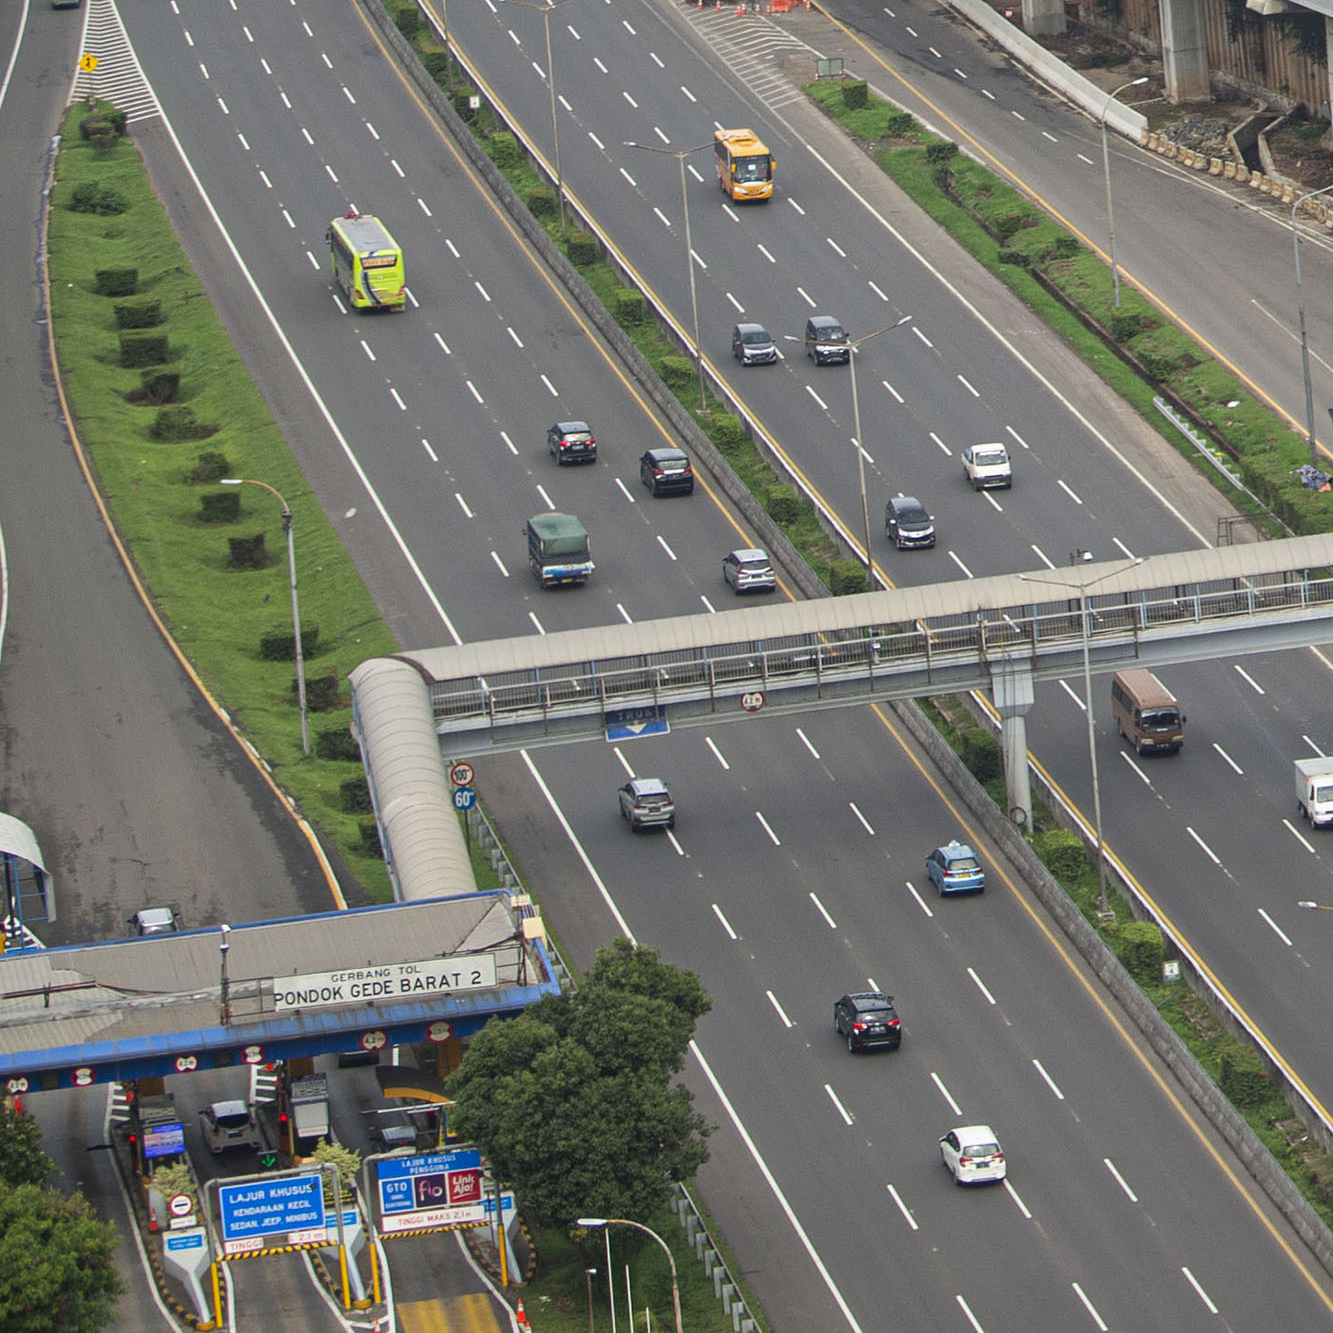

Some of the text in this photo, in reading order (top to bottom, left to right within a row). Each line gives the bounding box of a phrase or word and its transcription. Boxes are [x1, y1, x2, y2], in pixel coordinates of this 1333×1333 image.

[455, 791, 470, 807] 60
[331, 966, 421, 983] GERBANG TOL
[274, 971, 482, 1006] PONDOK GEDE BARAT 2
[402, 1154, 456, 1168] LAJUR KHUSUS
[409, 1164, 449, 1174] PENGGUNA
[452, 1175, 475, 1185] Link
[229, 1184, 313, 1204] LAJUR KHUSUS
[386, 1182, 408, 1193] GTO
[233, 1200, 312, 1217] KENDARAAN KECIL
[285, 1212, 318, 1223] MINIBUS
[398, 1216, 425, 1227] TINGGI
[427, 1213, 451, 1222] MAKS
[230, 1239, 263, 1251] TINGGI
